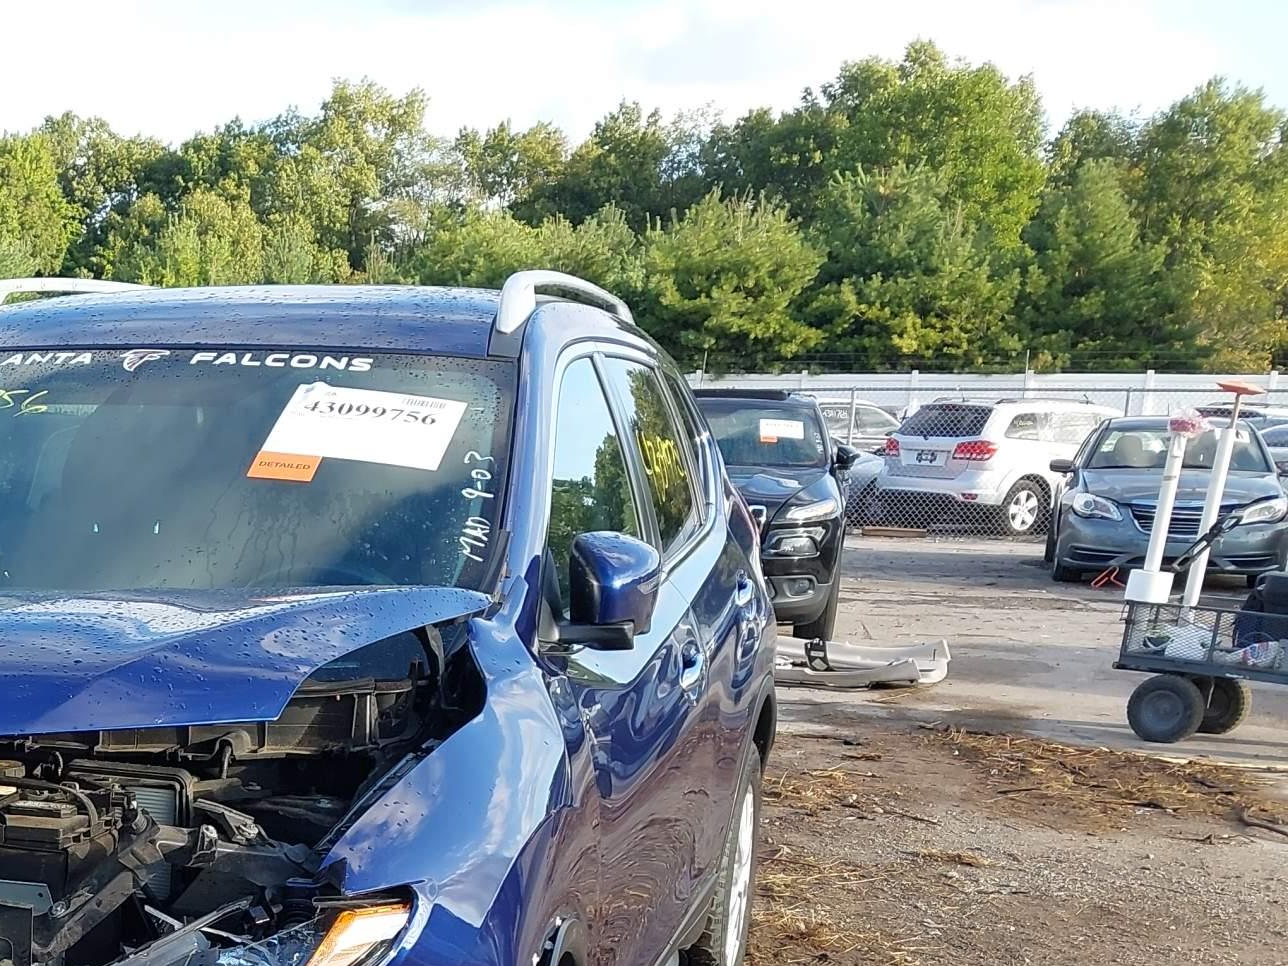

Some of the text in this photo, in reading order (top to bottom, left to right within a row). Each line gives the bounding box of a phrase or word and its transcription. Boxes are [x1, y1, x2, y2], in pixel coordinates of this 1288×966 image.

[190, 352, 374, 371] FALCONS
[304, 400, 439, 426] 43099756
[258, 460, 311, 471] DETAILED
[461, 450, 494, 499] 9-03
